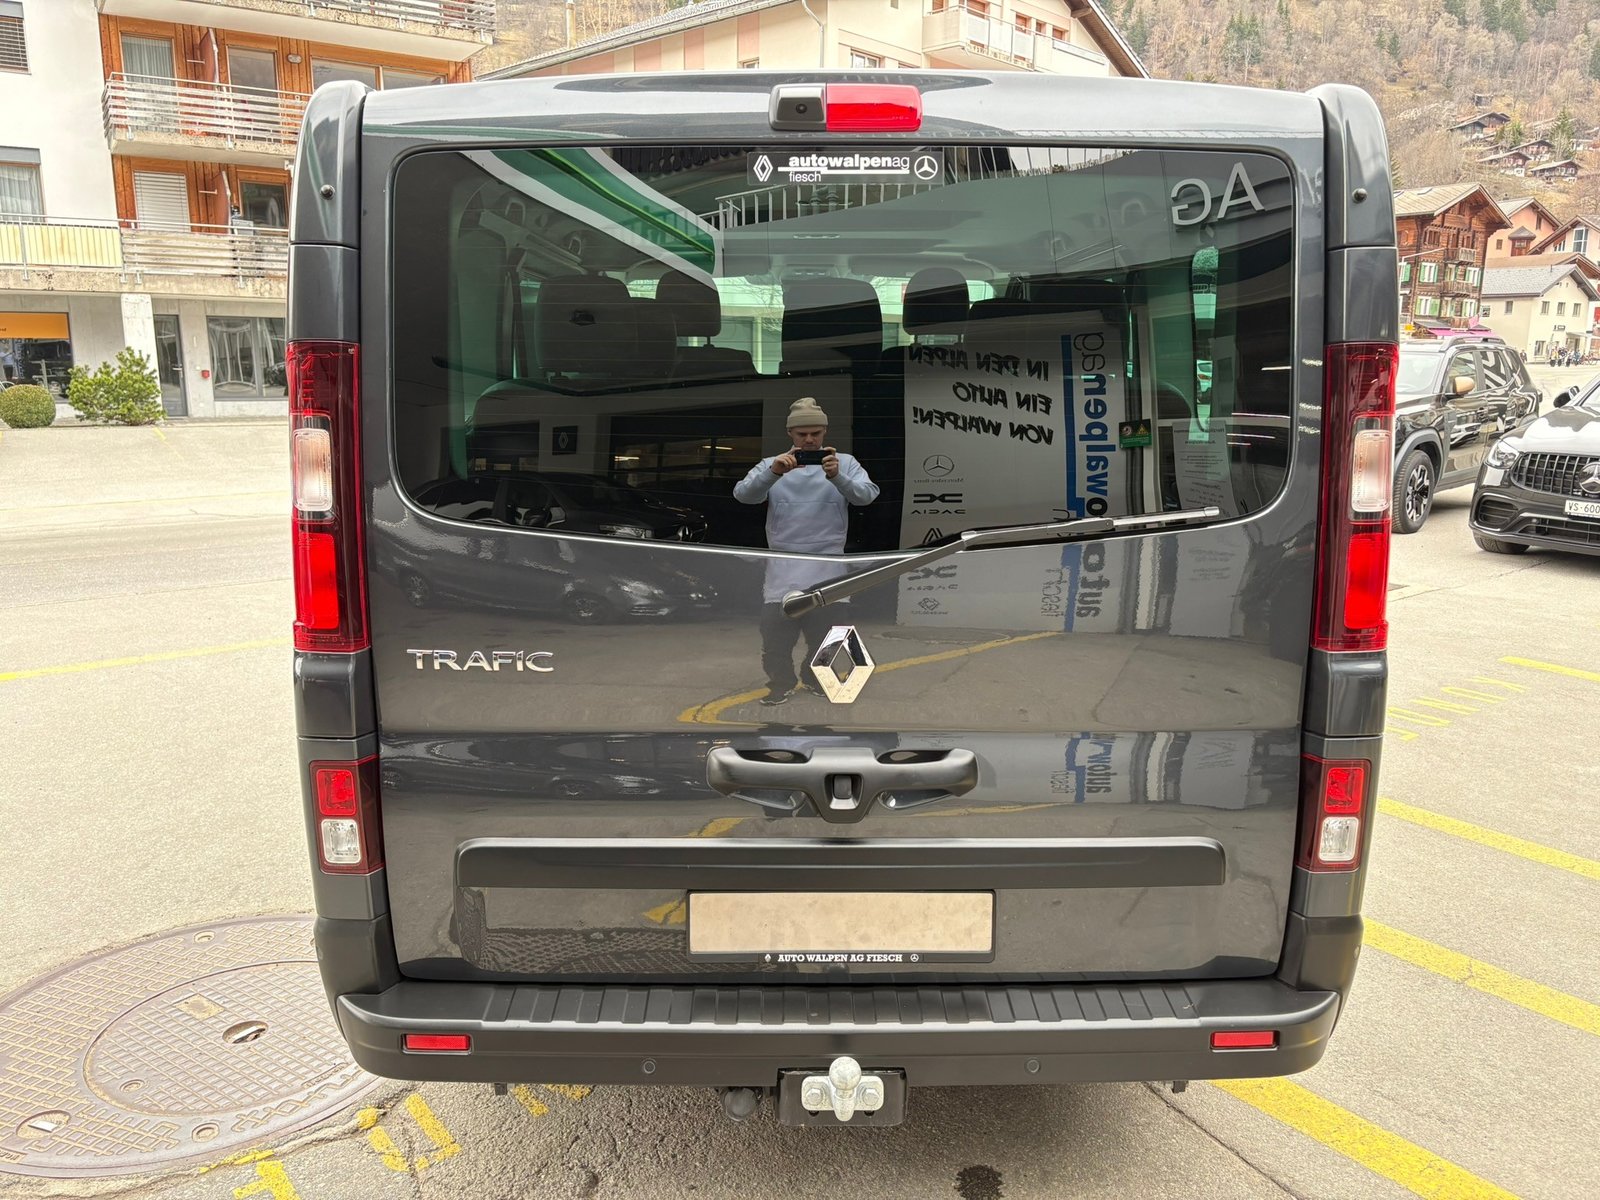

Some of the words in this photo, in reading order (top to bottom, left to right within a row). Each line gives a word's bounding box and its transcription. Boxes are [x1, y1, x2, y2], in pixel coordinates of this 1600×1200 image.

[788, 171, 822, 182] fiesch
[406, 648, 555, 673] TRAFIC
[777, 953, 805, 963] AUTO
[806, 953, 849, 963] WALPEN
[850, 953, 865, 963] AG
[866, 953, 903, 963] FIESCH
